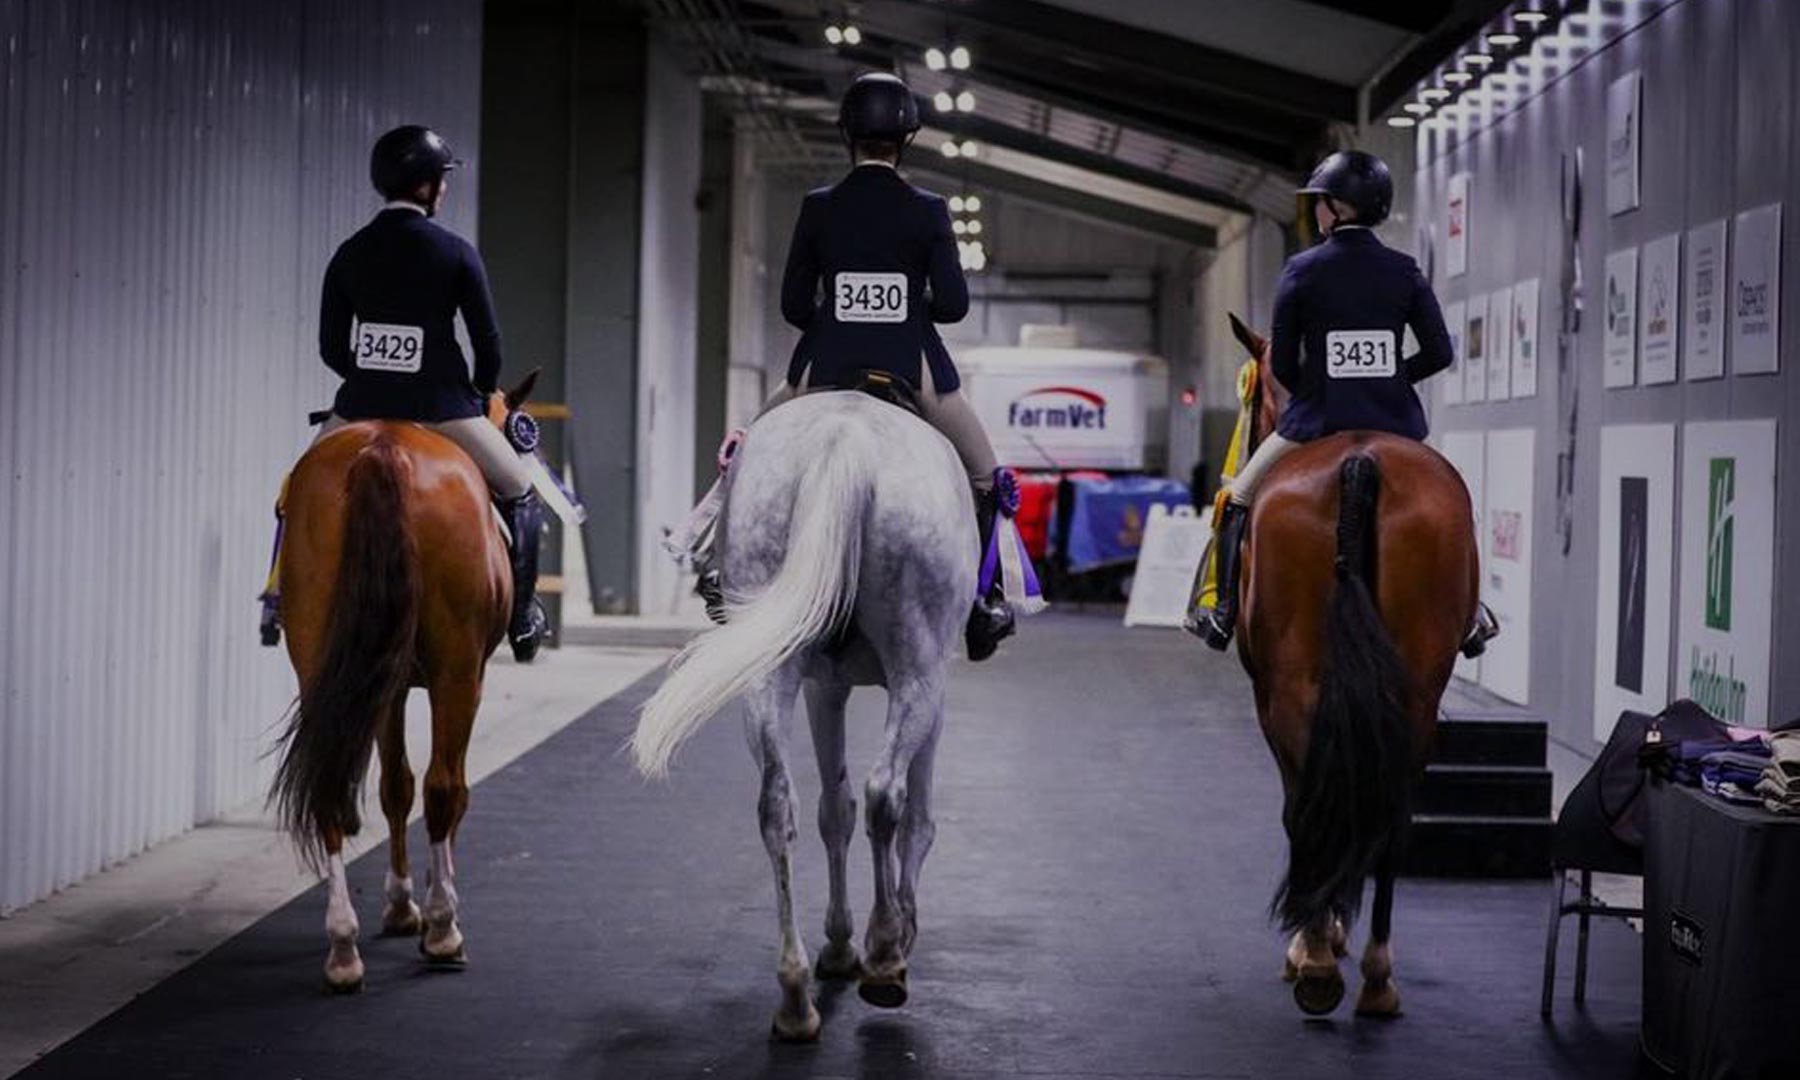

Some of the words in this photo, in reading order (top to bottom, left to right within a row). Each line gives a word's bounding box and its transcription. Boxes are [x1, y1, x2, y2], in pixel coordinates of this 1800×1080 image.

[841, 284, 902, 311] 3430
[361, 333, 417, 360] 3429
[1333, 341, 1387, 367] 3431
